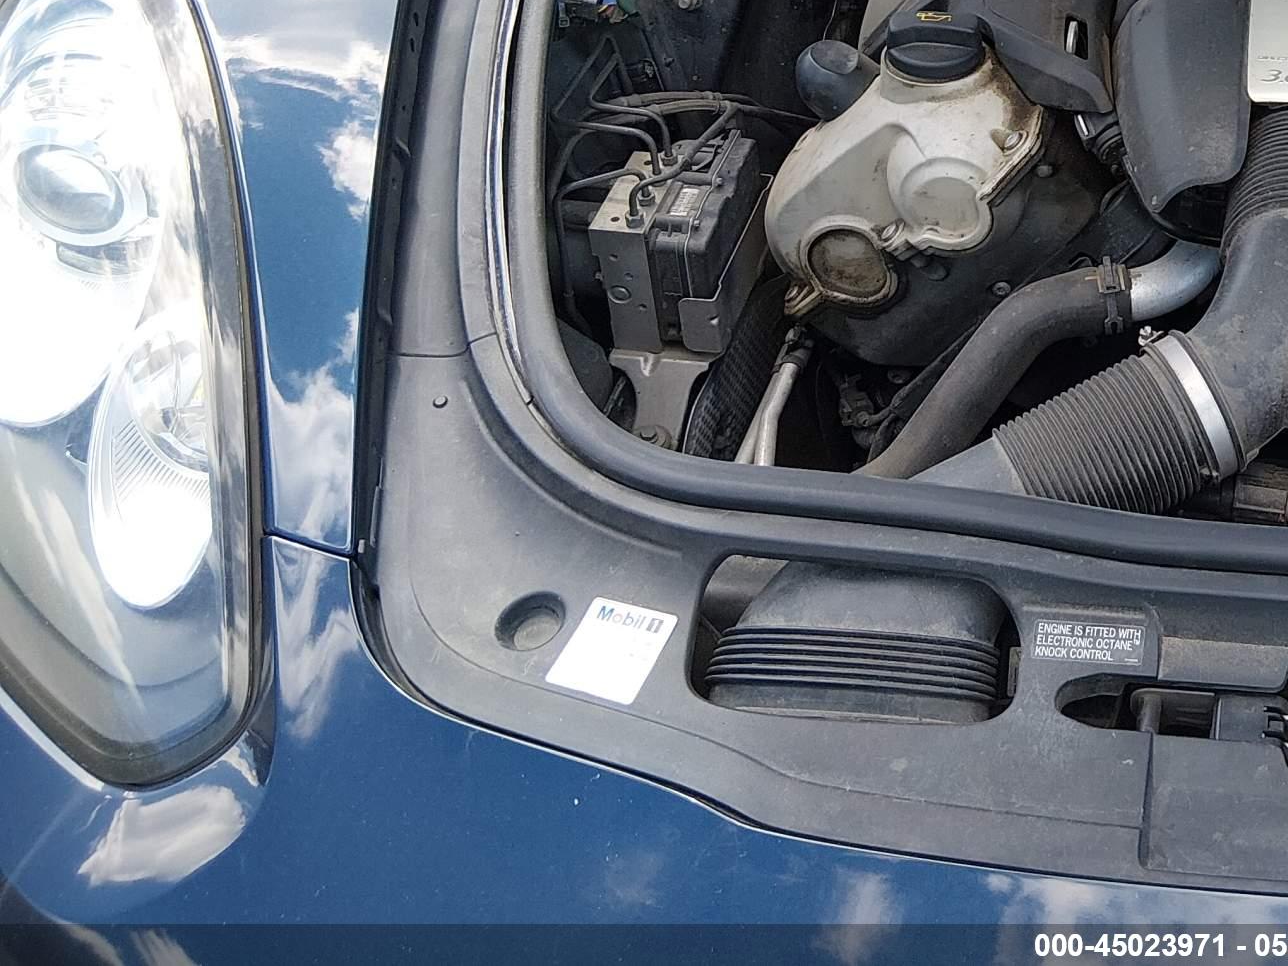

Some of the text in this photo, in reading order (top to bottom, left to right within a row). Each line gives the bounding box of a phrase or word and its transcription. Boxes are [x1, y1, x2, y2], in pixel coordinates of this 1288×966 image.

[596, 605, 647, 629] Mobil
[1038, 623, 1141, 640] ENGINE IS FITTED WITH
[1036, 634, 1093, 648] ELECTRONIC
[1035, 646, 1067, 659] KNOCK
[1070, 648, 1113, 661] CONTROL
